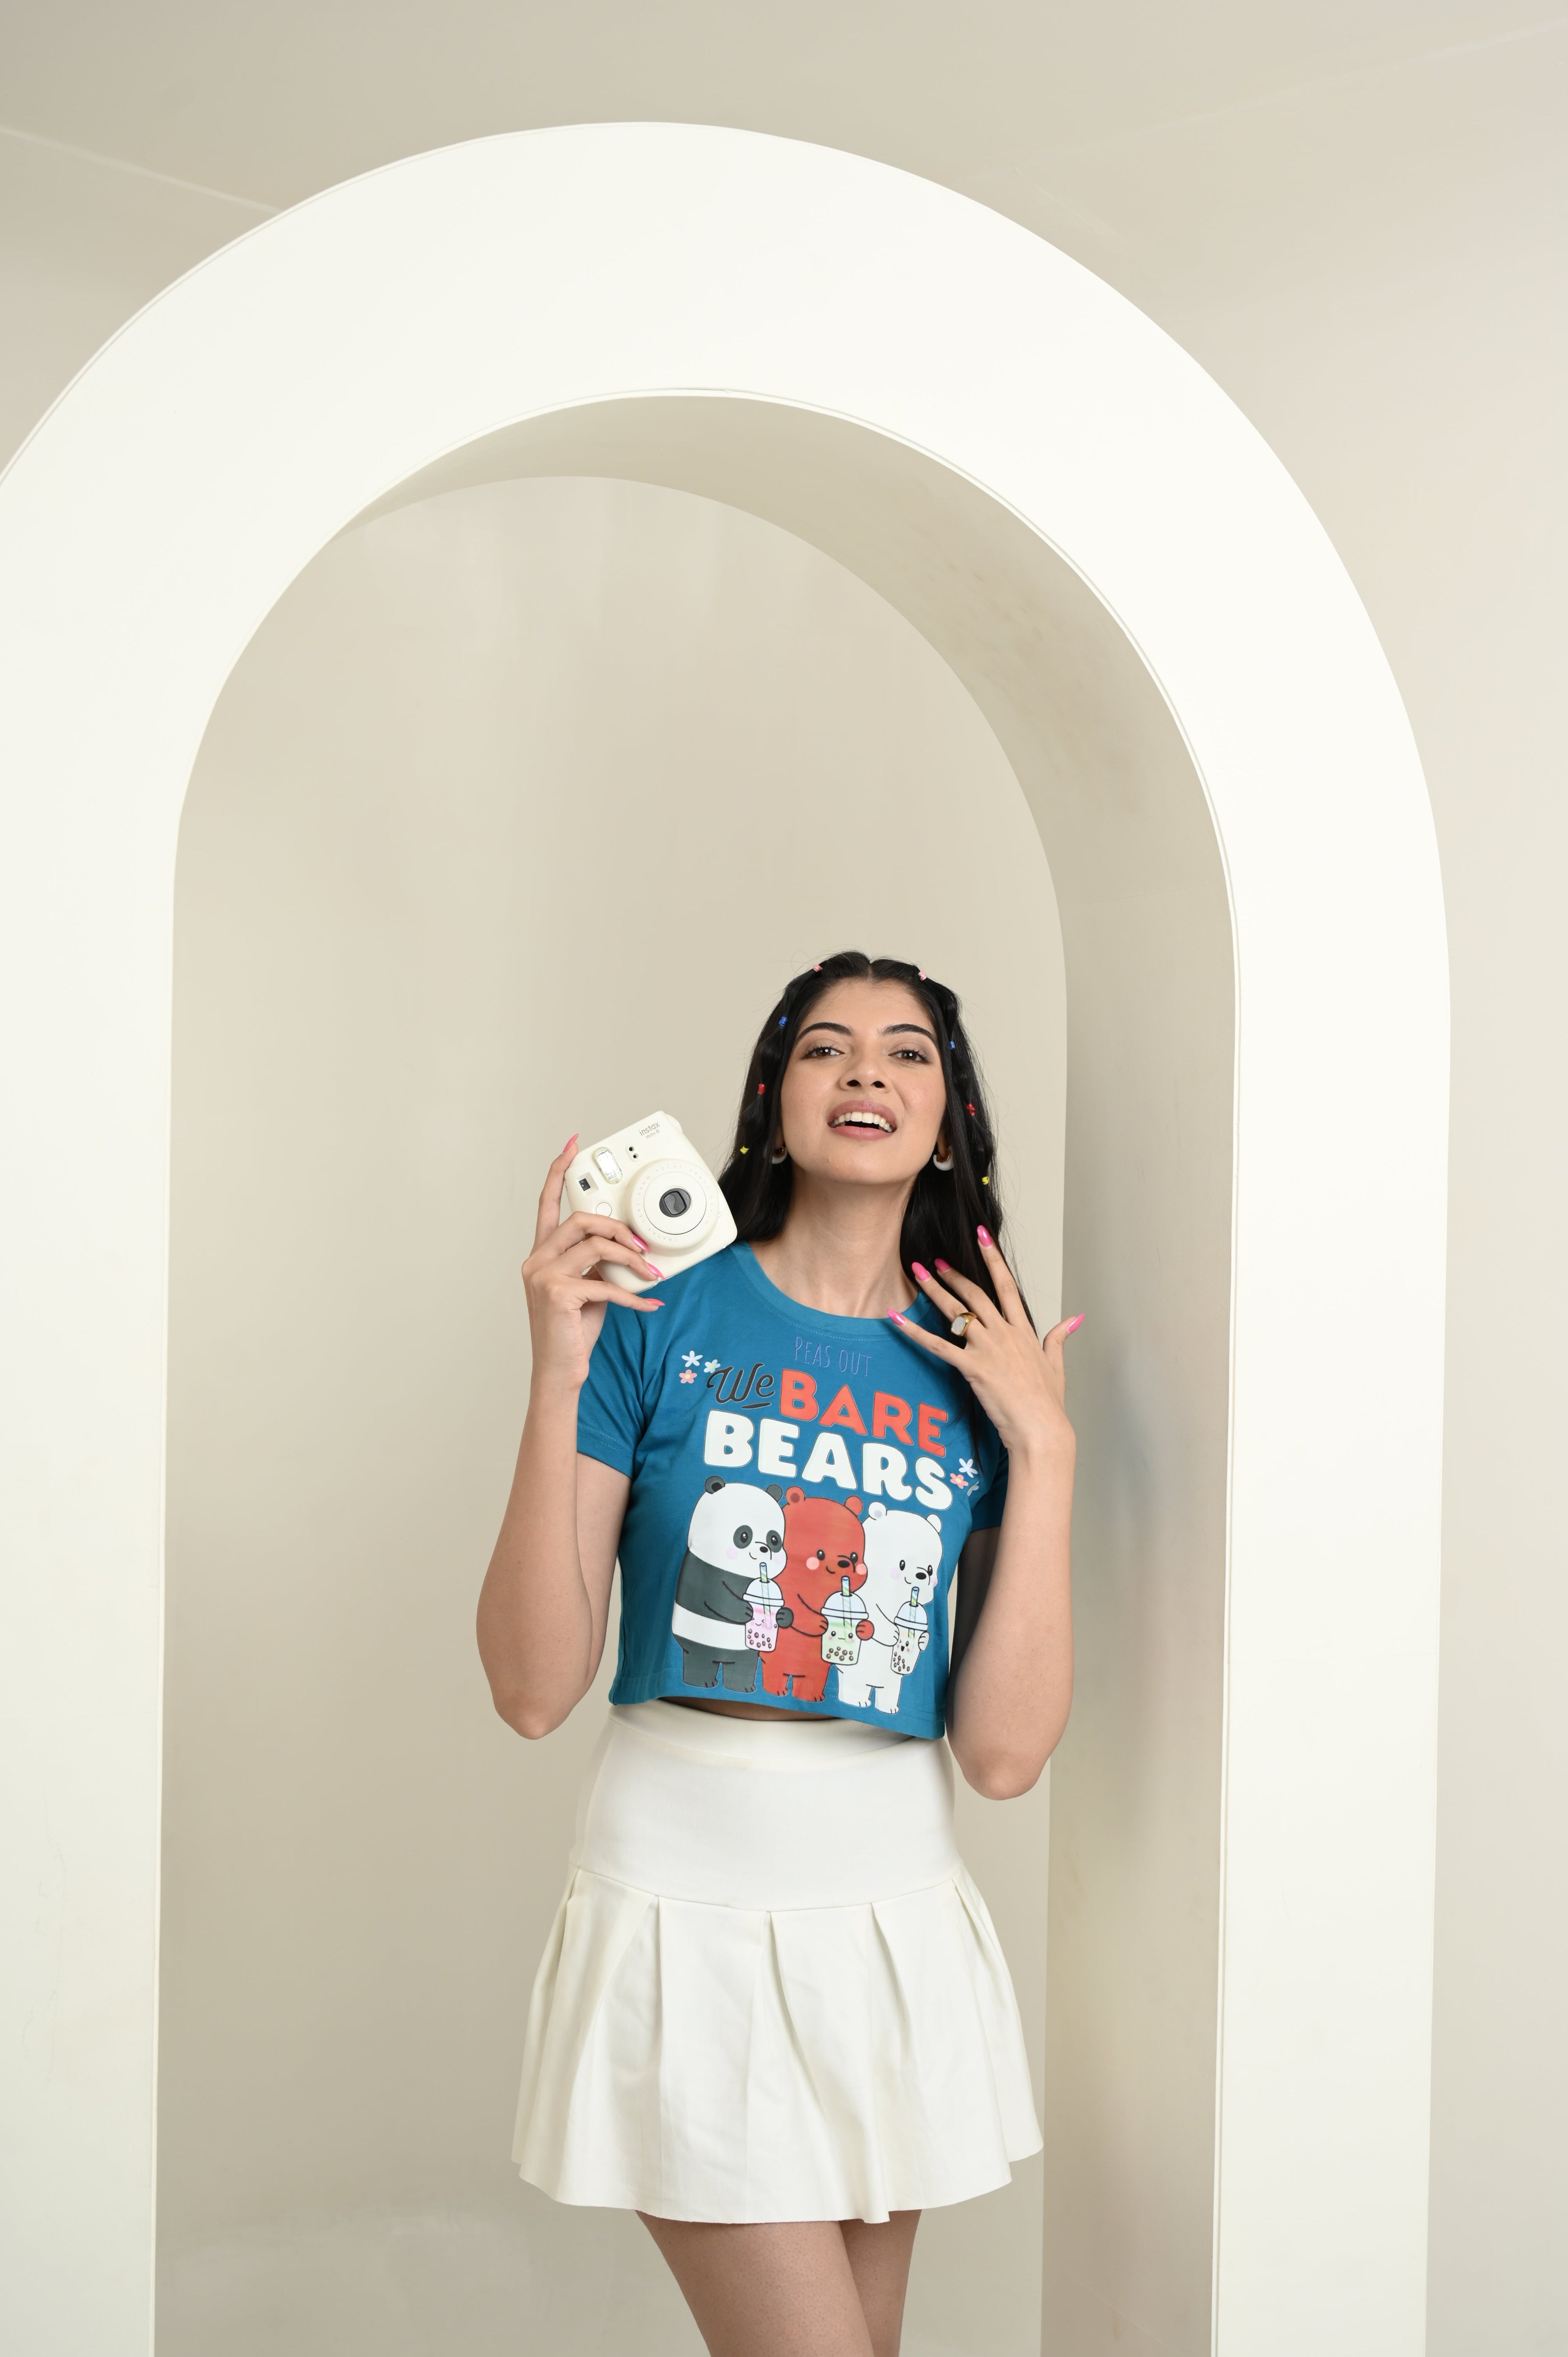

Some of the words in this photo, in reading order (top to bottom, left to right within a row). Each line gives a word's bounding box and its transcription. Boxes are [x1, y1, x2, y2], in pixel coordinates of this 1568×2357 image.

[638, 1122, 660, 1136] instax
[795, 1336, 830, 1368] PEAS
[839, 1349, 872, 1376] OUT
[706, 1362, 775, 1405] We
[780, 1368, 949, 1457] BARE
[704, 1409, 953, 1510] BEARS
